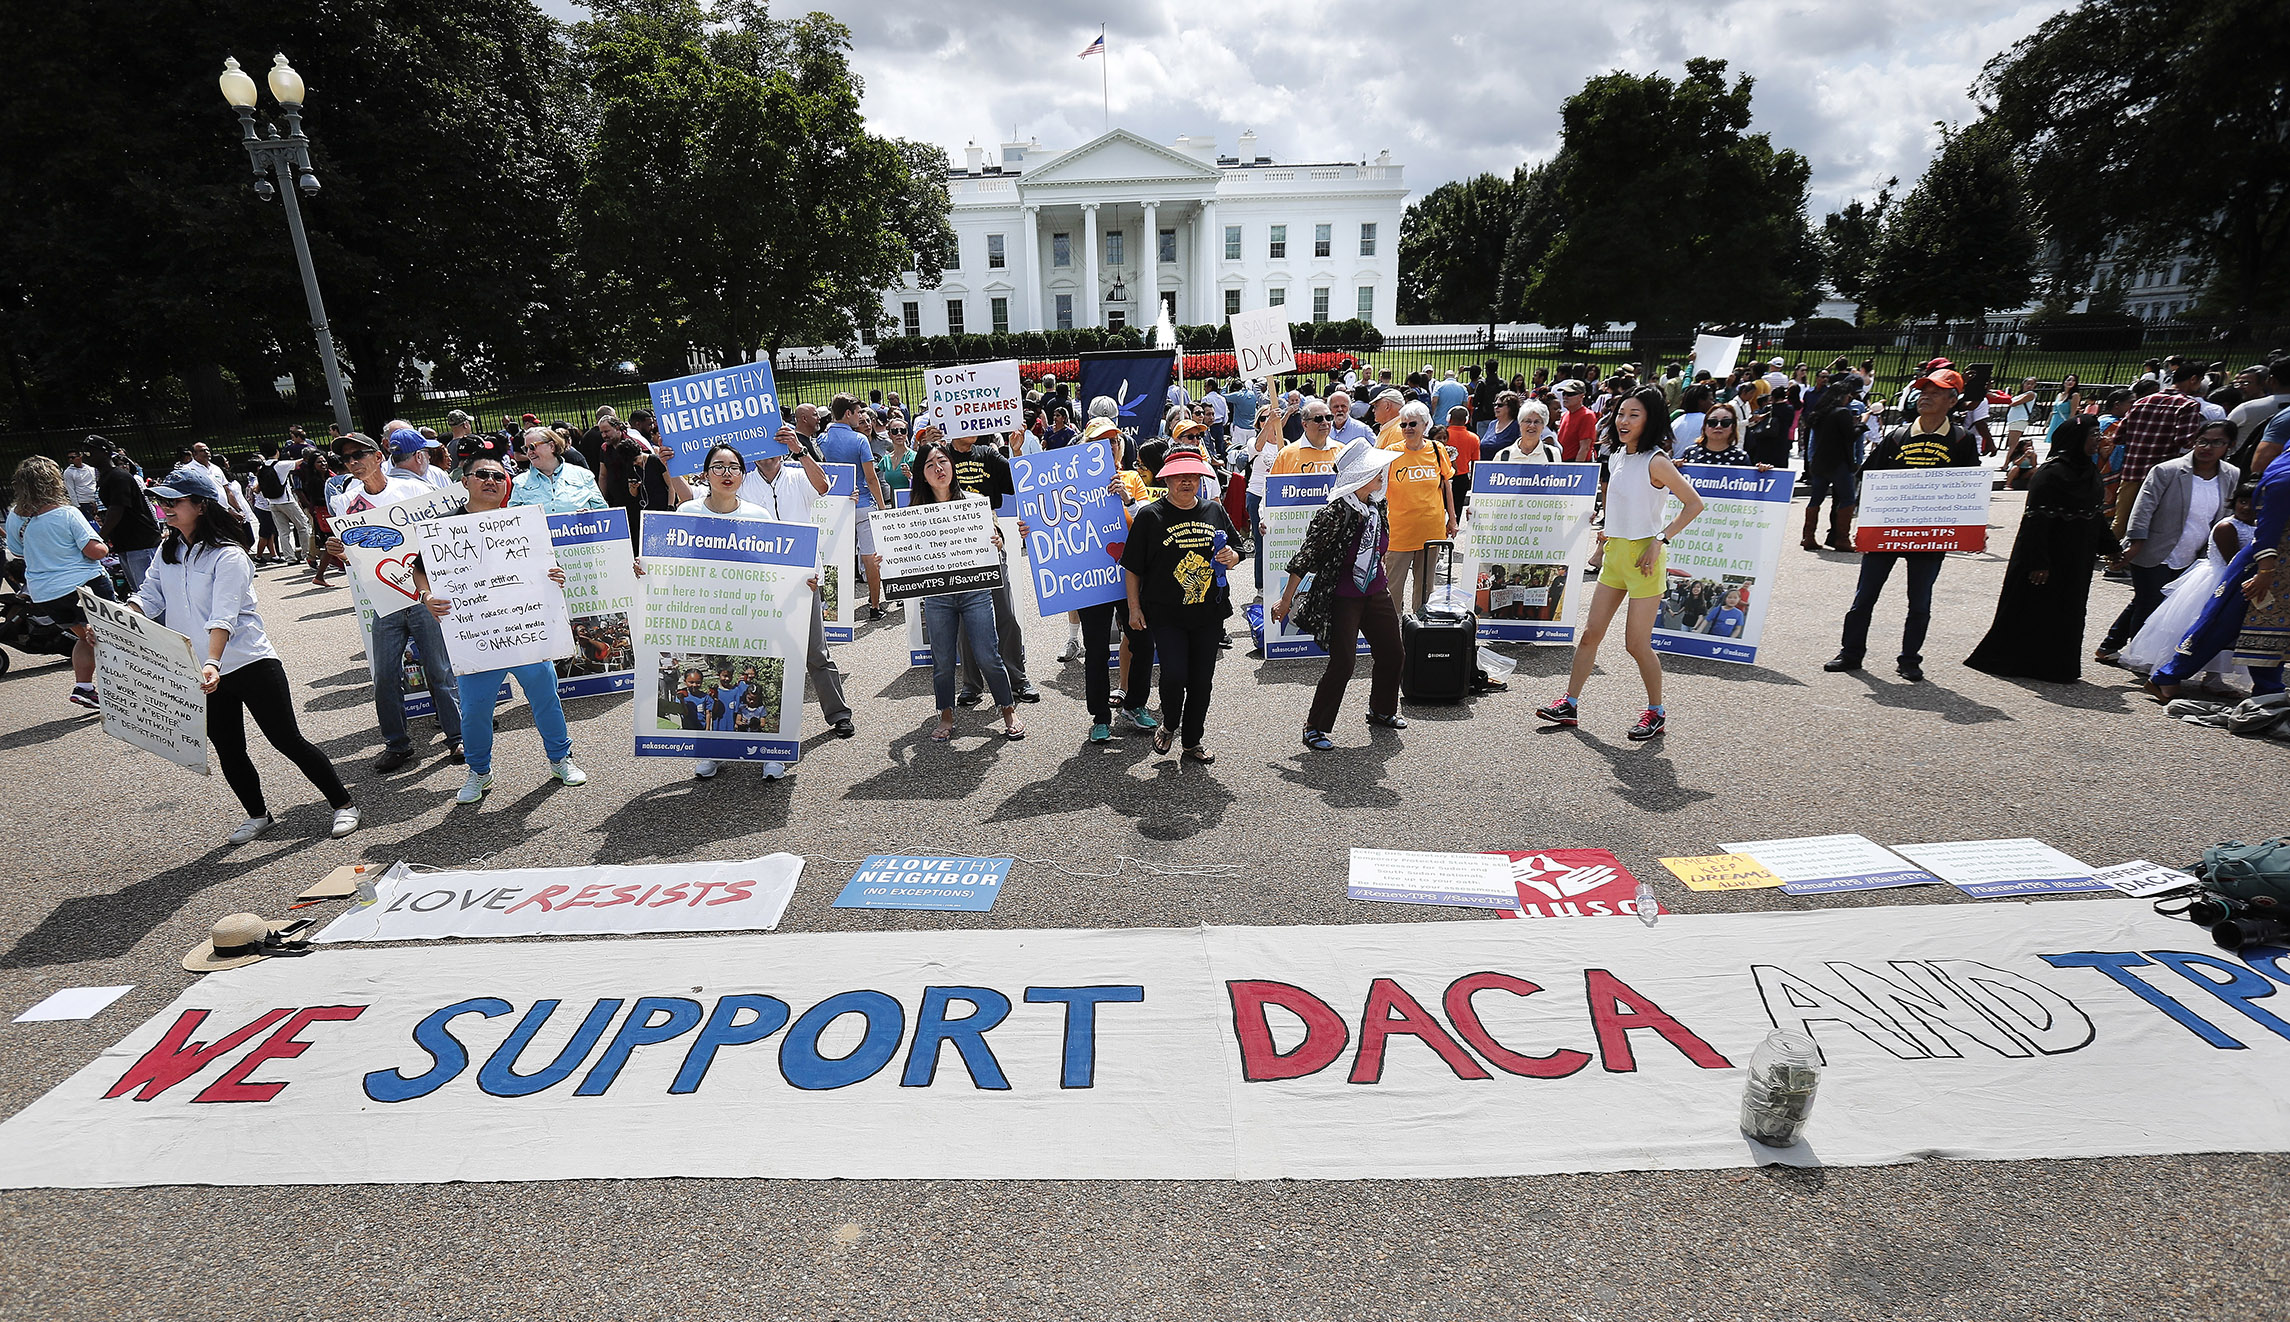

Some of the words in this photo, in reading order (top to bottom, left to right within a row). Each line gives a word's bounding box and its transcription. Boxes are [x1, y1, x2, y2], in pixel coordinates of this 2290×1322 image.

[1242, 317, 1278, 338] SAVE
[1242, 342, 1291, 372] DACA
[935, 370, 976, 385] DON'T
[945, 387, 1000, 402] DESTROY
[661, 393, 775, 434] NEIGHBOR
[935, 407, 943, 417] C
[954, 398, 1018, 416] DREAMERS'
[961, 415, 1011, 430] DREAMS
[682, 440, 699, 454] (NO
[702, 426, 768, 448] EXCEPTIONS)
[1014, 460, 1035, 492] 2
[1038, 462, 1062, 487] out
[1066, 454, 1079, 480] of
[1087, 443, 1105, 476] 3
[1408, 468, 1438, 480] LOVE
[1489, 472, 1582, 488] #DreamAction17
[389, 501, 440, 526] Quiet
[442, 495, 468, 510] the
[884, 509, 922, 519] President,
[924, 506, 940, 514] DHS
[954, 502, 971, 511] urge
[974, 500, 988, 508] you
[1022, 500, 1038, 517] in
[1037, 485, 1083, 527] US
[1475, 499, 1516, 508] PRESIDENT
[1527, 500, 1568, 509] CONGRESS
[334, 516, 366, 532] Mind
[420, 523, 442, 538] If
[449, 525, 468, 540] you
[479, 516, 521, 532] support
[910, 520, 927, 528] strip
[929, 516, 950, 525] LEGAL
[953, 512, 981, 521] STATUS
[1934, 516, 1959, 524] thing.
[666, 528, 795, 554] #DreamAction17
[903, 530, 937, 540] 300,000
[939, 526, 965, 536] people
[1031, 519, 1103, 565] DACA
[1102, 517, 1121, 534] and
[506, 546, 530, 560] Act
[894, 544, 912, 552] need
[1878, 542, 1958, 550] #TPSforHaiti
[886, 554, 922, 565] WORKING
[924, 552, 947, 560] CLASS
[950, 549, 973, 557] whom
[431, 570, 446, 582] you
[454, 565, 472, 574] can:
[647, 564, 706, 578] PRESIDENT
[710, 568, 717, 578] &
[722, 568, 777, 582] CONGRESS
[901, 564, 934, 576] promised
[948, 559, 977, 570] protect.
[474, 579, 486, 588] our
[490, 574, 519, 588] petition
[886, 578, 944, 593] #RenewTPS
[949, 570, 1000, 585] #SaveTPS
[452, 594, 488, 610] Donate
[646, 584, 649, 594] I
[653, 587, 668, 595] am
[673, 585, 696, 597] here
[699, 588, 709, 598] to
[713, 588, 741, 600] stand
[745, 592, 756, 605] up
[760, 590, 774, 602] for
[82, 593, 144, 634] DACA
[646, 603, 662, 611] our
[666, 601, 705, 613] children
[710, 604, 727, 615] and
[731, 605, 748, 616] call
[751, 608, 769, 620] you
[772, 608, 782, 618] to
[505, 624, 522, 633] social
[645, 617, 687, 629] DEFEND
[691, 618, 721, 631] DACA
[725, 621, 733, 632] &
[476, 631, 548, 651] @NAKASEC
[644, 634, 672, 646] PASS
[676, 634, 696, 647] THE
[701, 636, 739, 649] DREAM
[743, 639, 767, 650] ACT!
[99, 650, 107, 658] IS
[125, 660, 164, 682] PROGRAM
[169, 680, 188, 693] THAT
[101, 665, 128, 682] ALLOWS
[133, 679, 157, 693] YOUNG
[160, 690, 204, 713] IMMIGRANTS
[107, 713, 116, 722] OF
[175, 711, 191, 720] AND
[105, 700, 130, 717] FUTURE
[137, 715, 174, 736] WITHOUT
[182, 734, 200, 748] FEAR
[642, 742, 694, 752] nakasec.org/act
[760, 747, 791, 755] @nakasec
[1673, 854, 1743, 866] AMERICA
[1691, 870, 1772, 883] DREAMS
[1700, 864, 1736, 873] KEEP
[2095, 864, 2159, 881] DEFEND
[857, 871, 999, 886] NEIGHBOR
[1786, 878, 1862, 891] #RenewTPS
[1865, 872, 1931, 884] #SaveTPS
[2115, 872, 2186, 892] DACA
[863, 887, 887, 896] (NO
[890, 888, 974, 898] EXCEPTIONS)
[1354, 889, 1437, 901] #RenewTPS
[1443, 895, 1514, 905] #SaveTPS
[100, 1004, 371, 1103] WE
[362, 985, 1144, 1102] SUPPORT
[1225, 968, 1735, 1084] DACA
[1750, 959, 2096, 1066] AND
